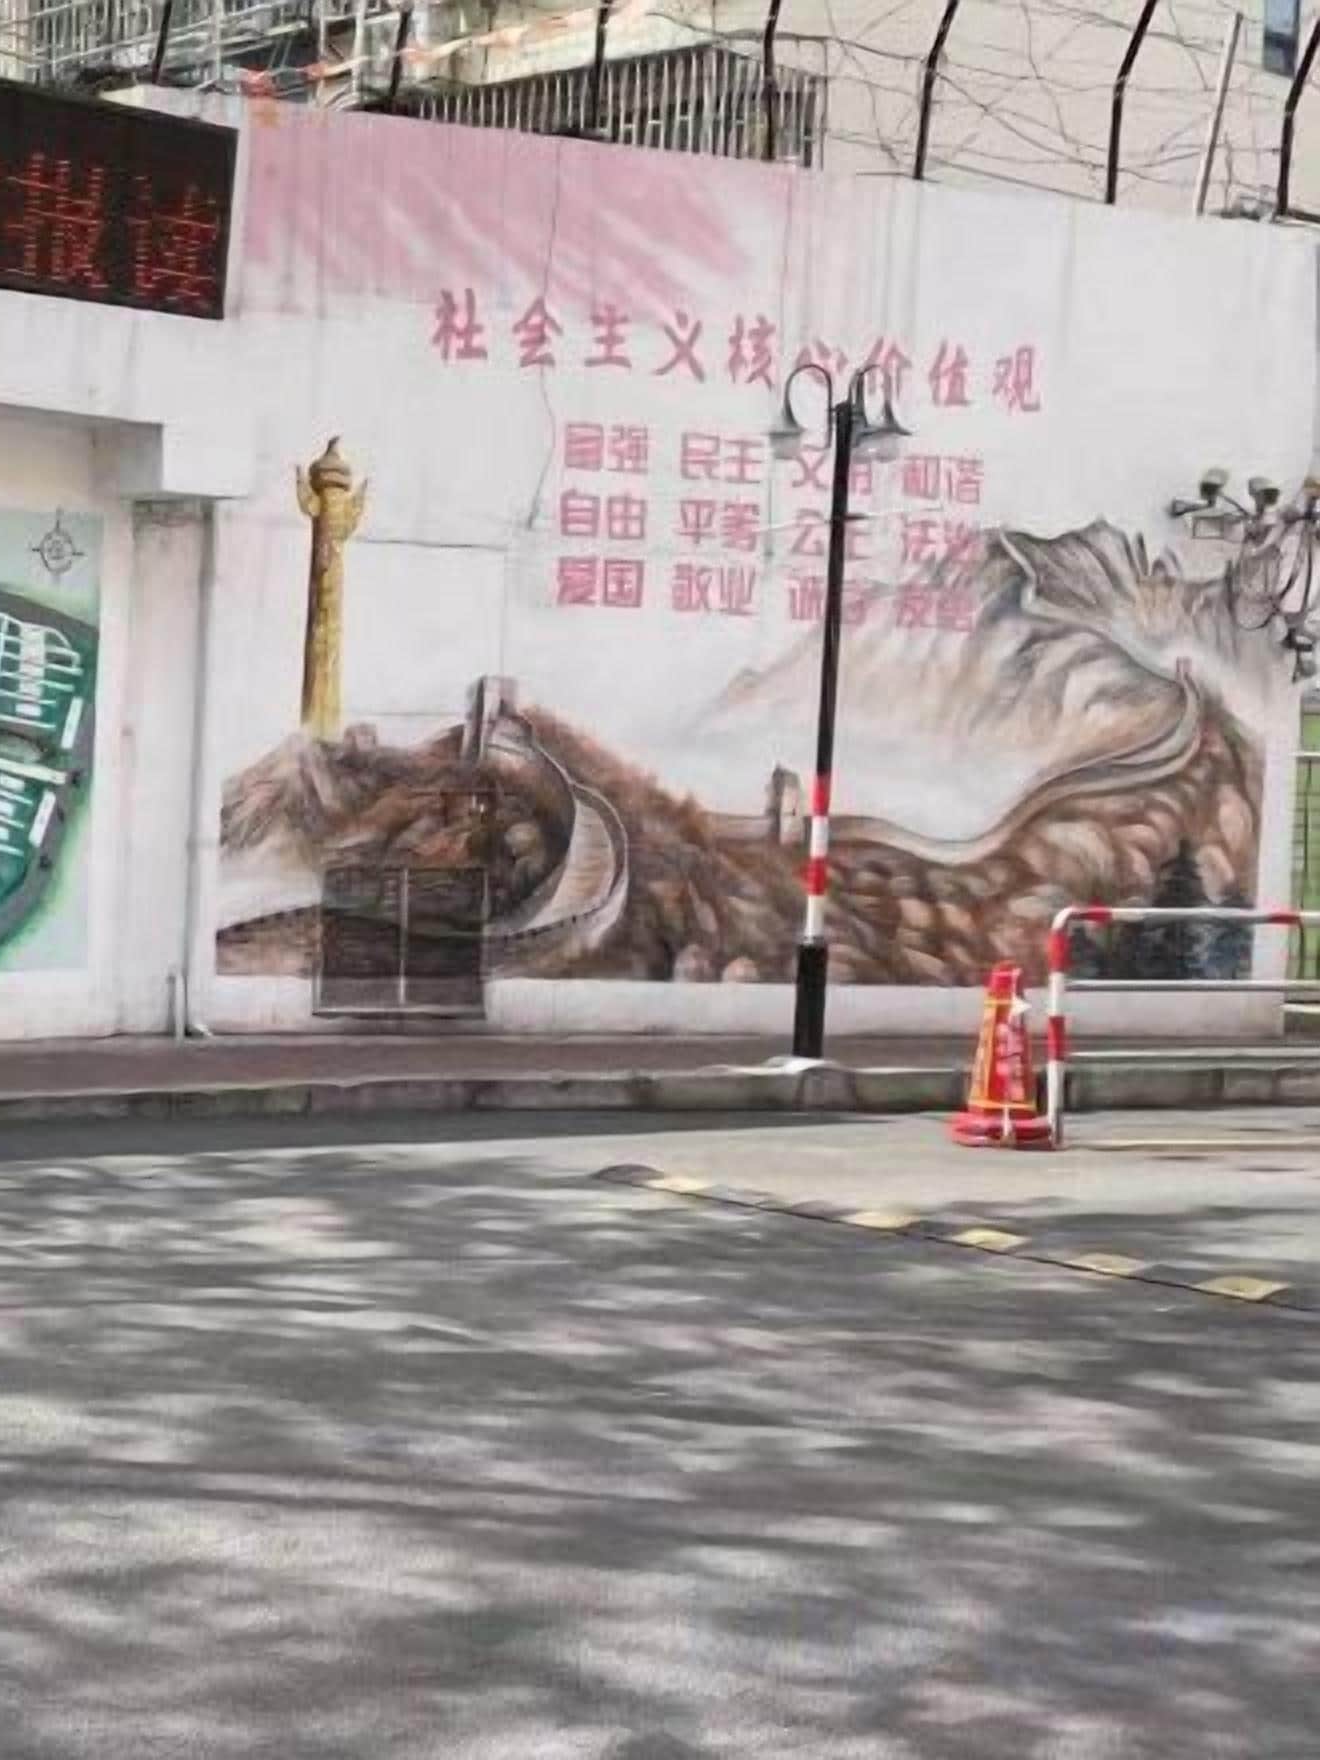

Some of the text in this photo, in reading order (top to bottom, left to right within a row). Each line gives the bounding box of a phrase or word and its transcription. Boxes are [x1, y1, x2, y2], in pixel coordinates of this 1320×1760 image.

[431, 287, 1042, 412] 社会主义核心价值观
[560, 488, 646, 540] 自由
[675, 499, 761, 552] 平等
[557, 555, 644, 608] 爱国
[672, 563, 760, 616] 敬业
